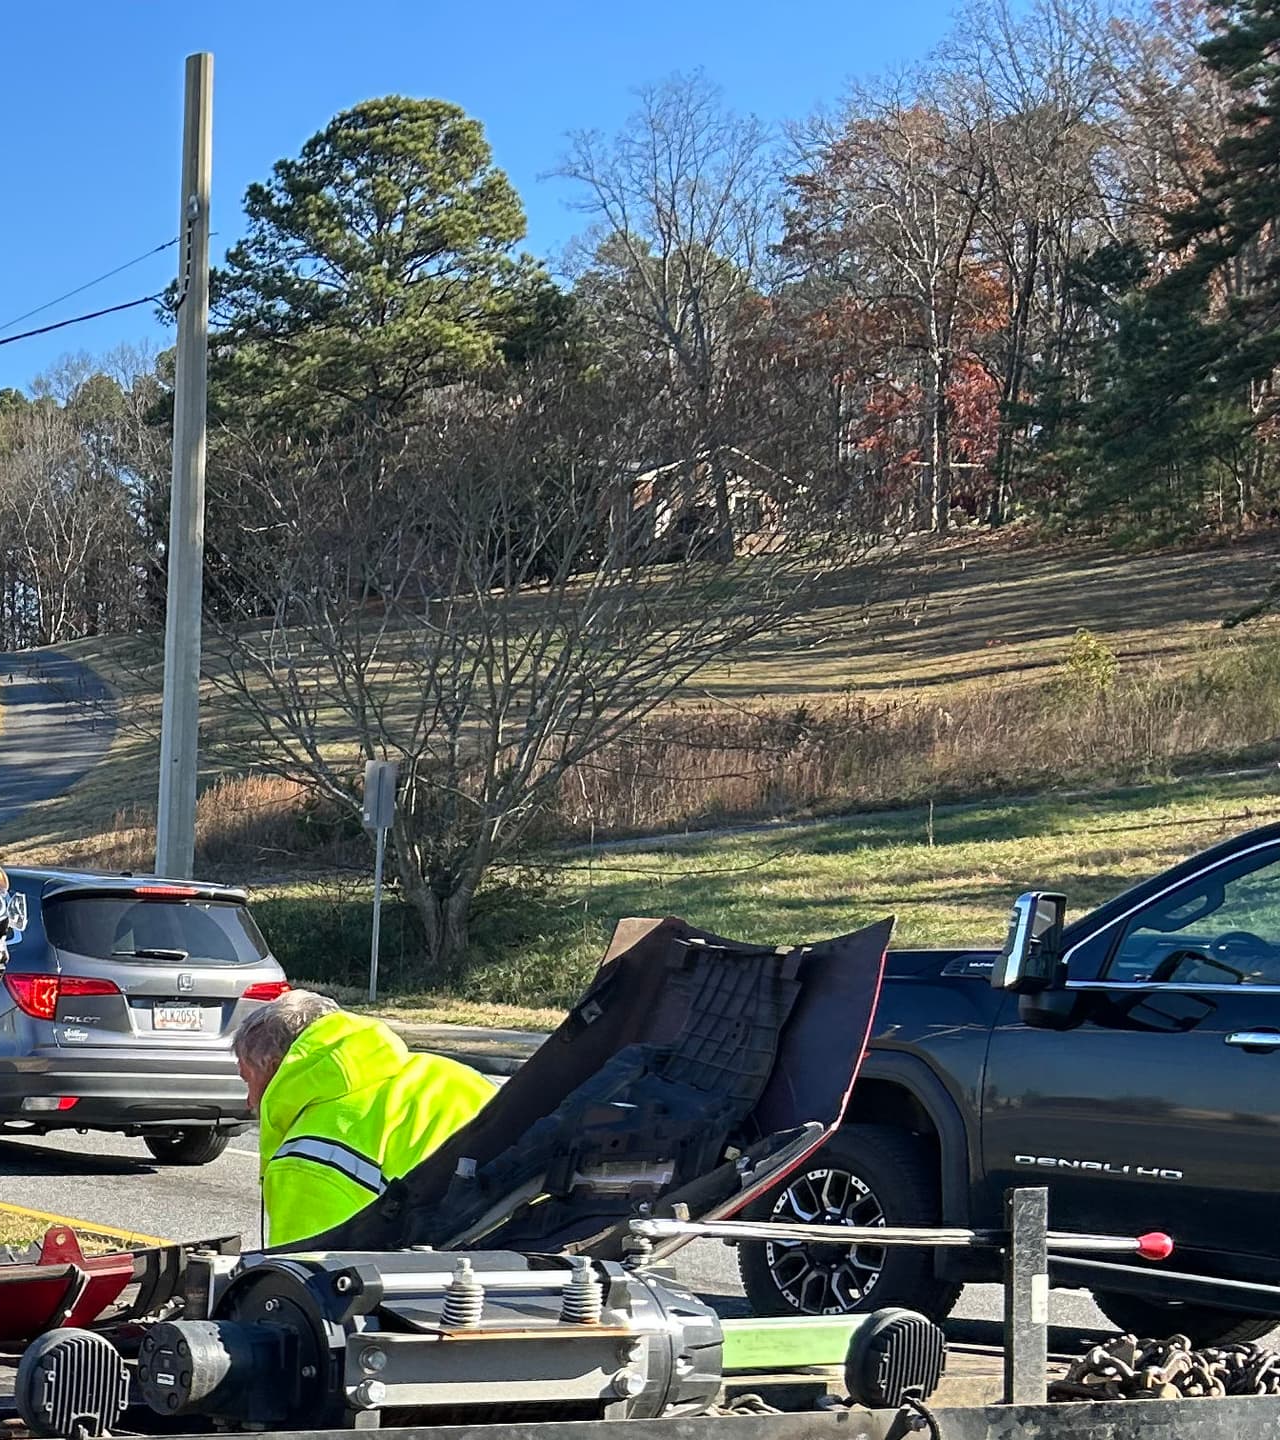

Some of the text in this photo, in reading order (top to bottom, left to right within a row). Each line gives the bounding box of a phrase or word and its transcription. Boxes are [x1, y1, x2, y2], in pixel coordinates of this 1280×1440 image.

[62, 1015, 101, 1024] PILOT
[1014, 1154, 1183, 1180] DENALI HD
